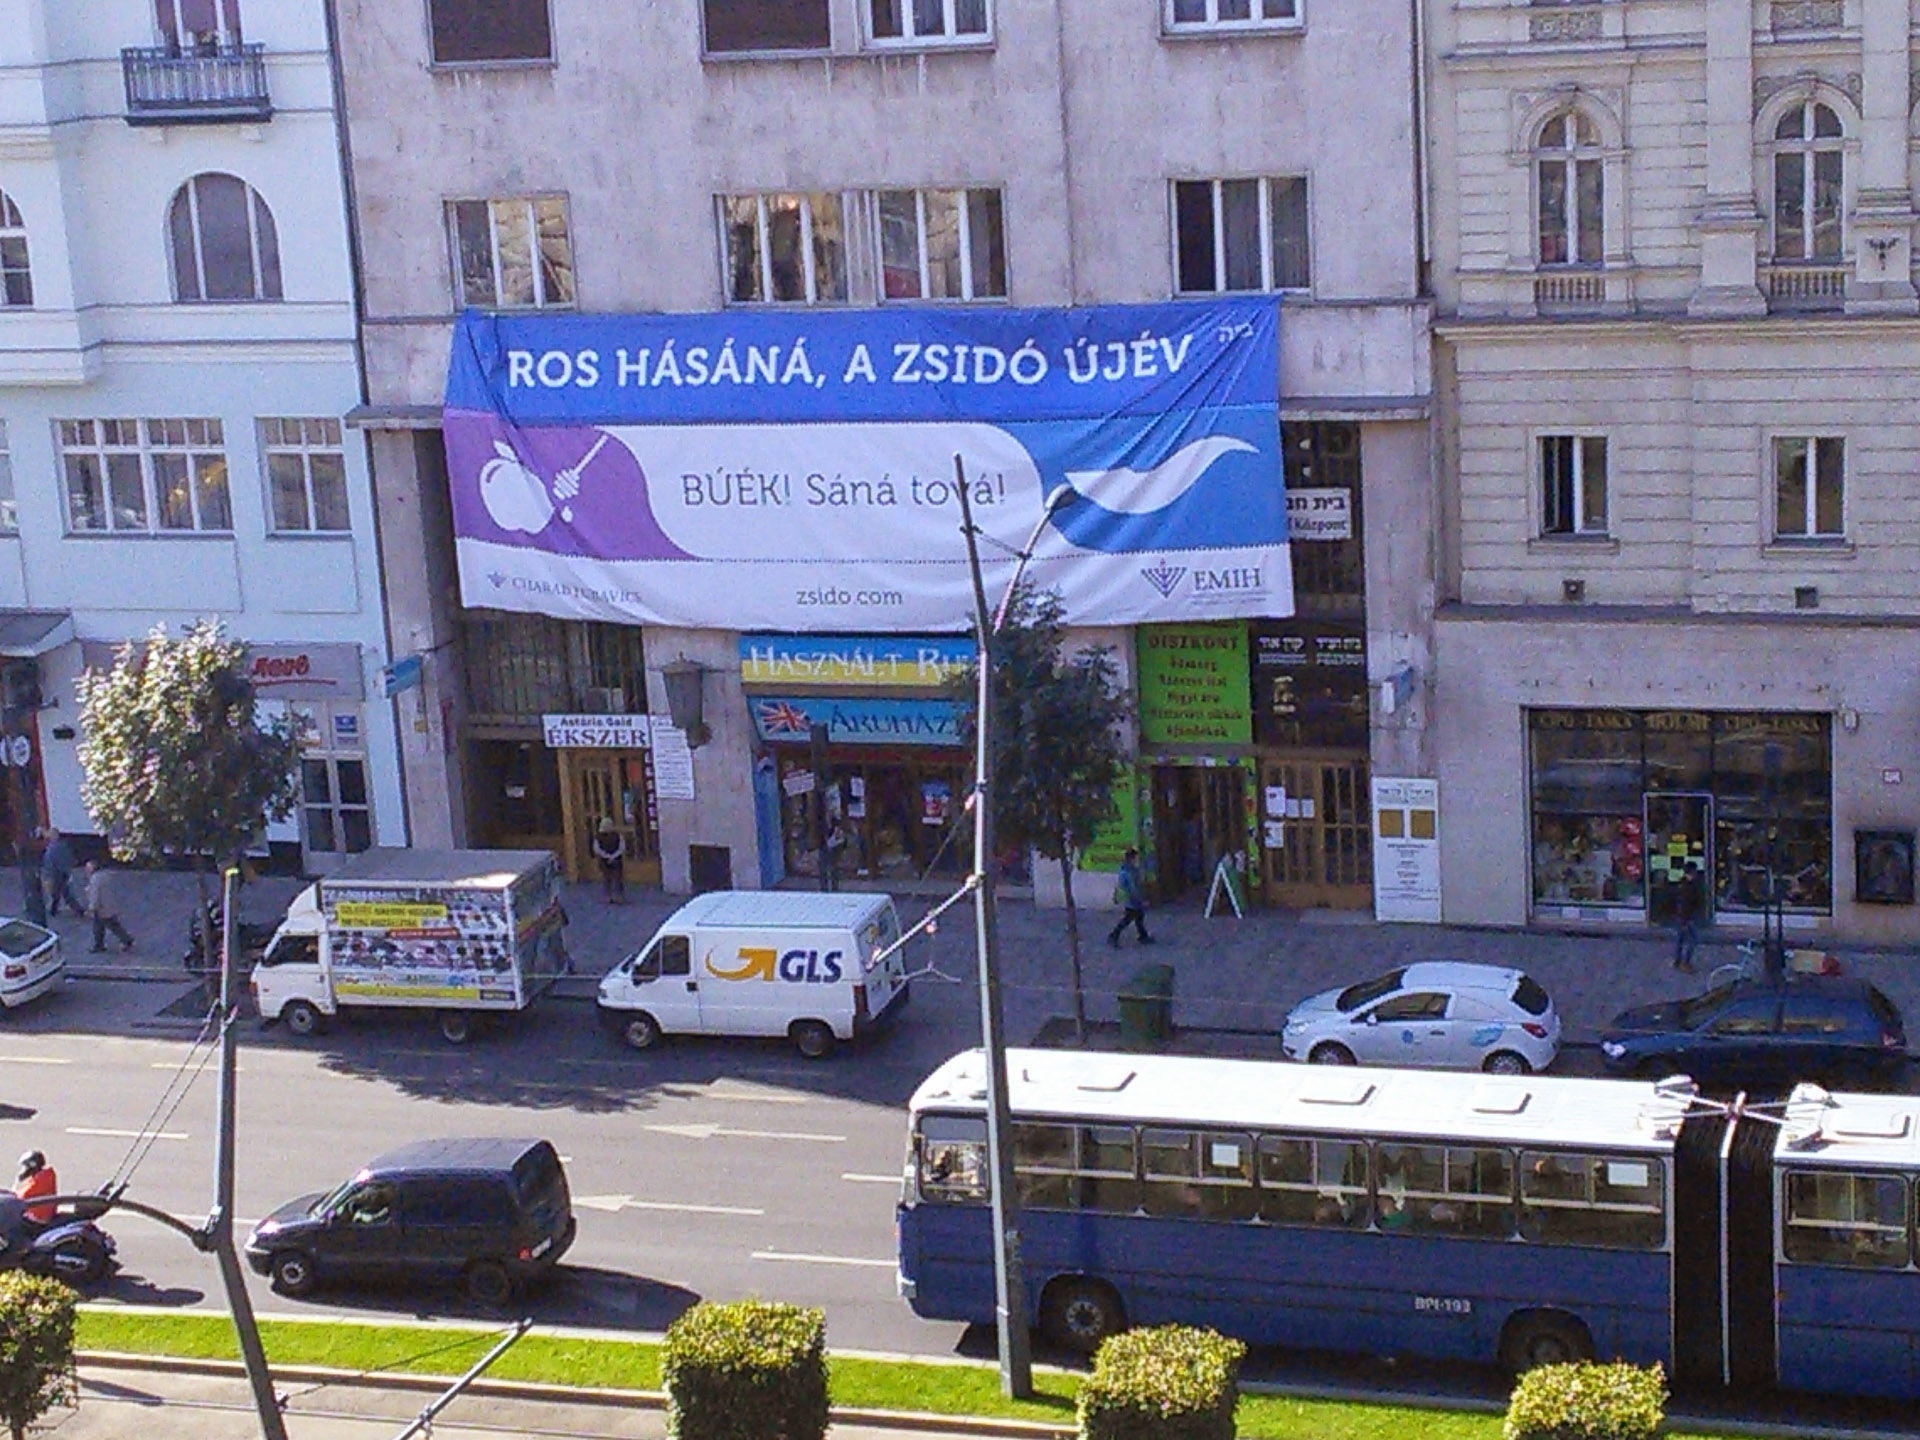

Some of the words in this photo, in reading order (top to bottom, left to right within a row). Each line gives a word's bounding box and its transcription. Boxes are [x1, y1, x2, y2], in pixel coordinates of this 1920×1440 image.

[507, 349, 599, 388] ROS
[615, 337, 827, 389] HÁSÁNÁ,
[842, 345, 877, 384] A
[892, 337, 1049, 385] ZSIDÓ
[1063, 330, 1195, 383] ÚJÉV
[681, 466, 792, 506] BÚÉK!
[806, 469, 896, 506] Sáná
[1193, 567, 1261, 592] EMIH
[796, 586, 902, 606] zsido.com
[547, 724, 647, 747] ÉKSZER
[779, 950, 843, 983] GLS
